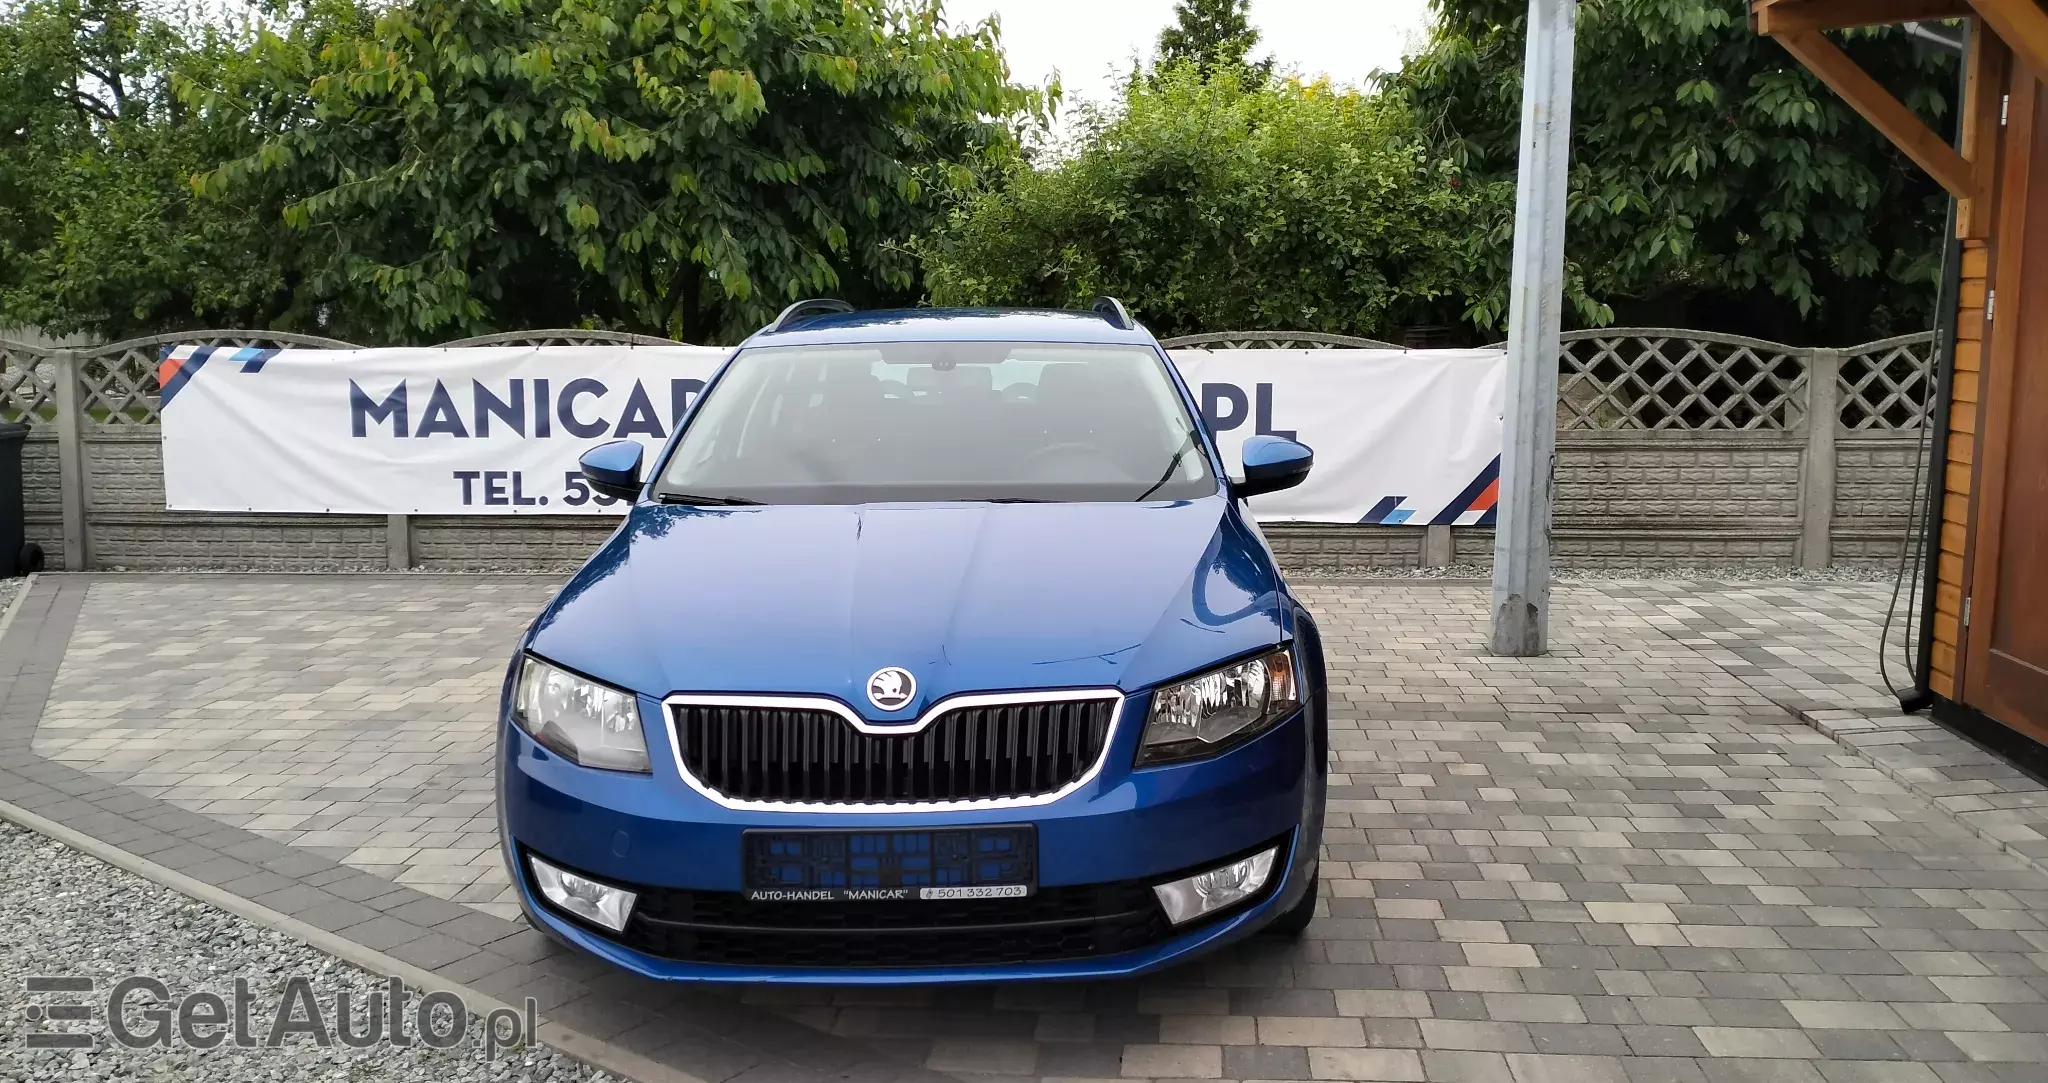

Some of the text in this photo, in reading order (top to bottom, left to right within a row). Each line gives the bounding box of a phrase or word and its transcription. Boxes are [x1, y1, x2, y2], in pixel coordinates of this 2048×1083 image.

[453, 471, 548, 505] TEL.
[751, 886, 1022, 900] AUTO-HANDEL "MANICAR" 501 332 703
